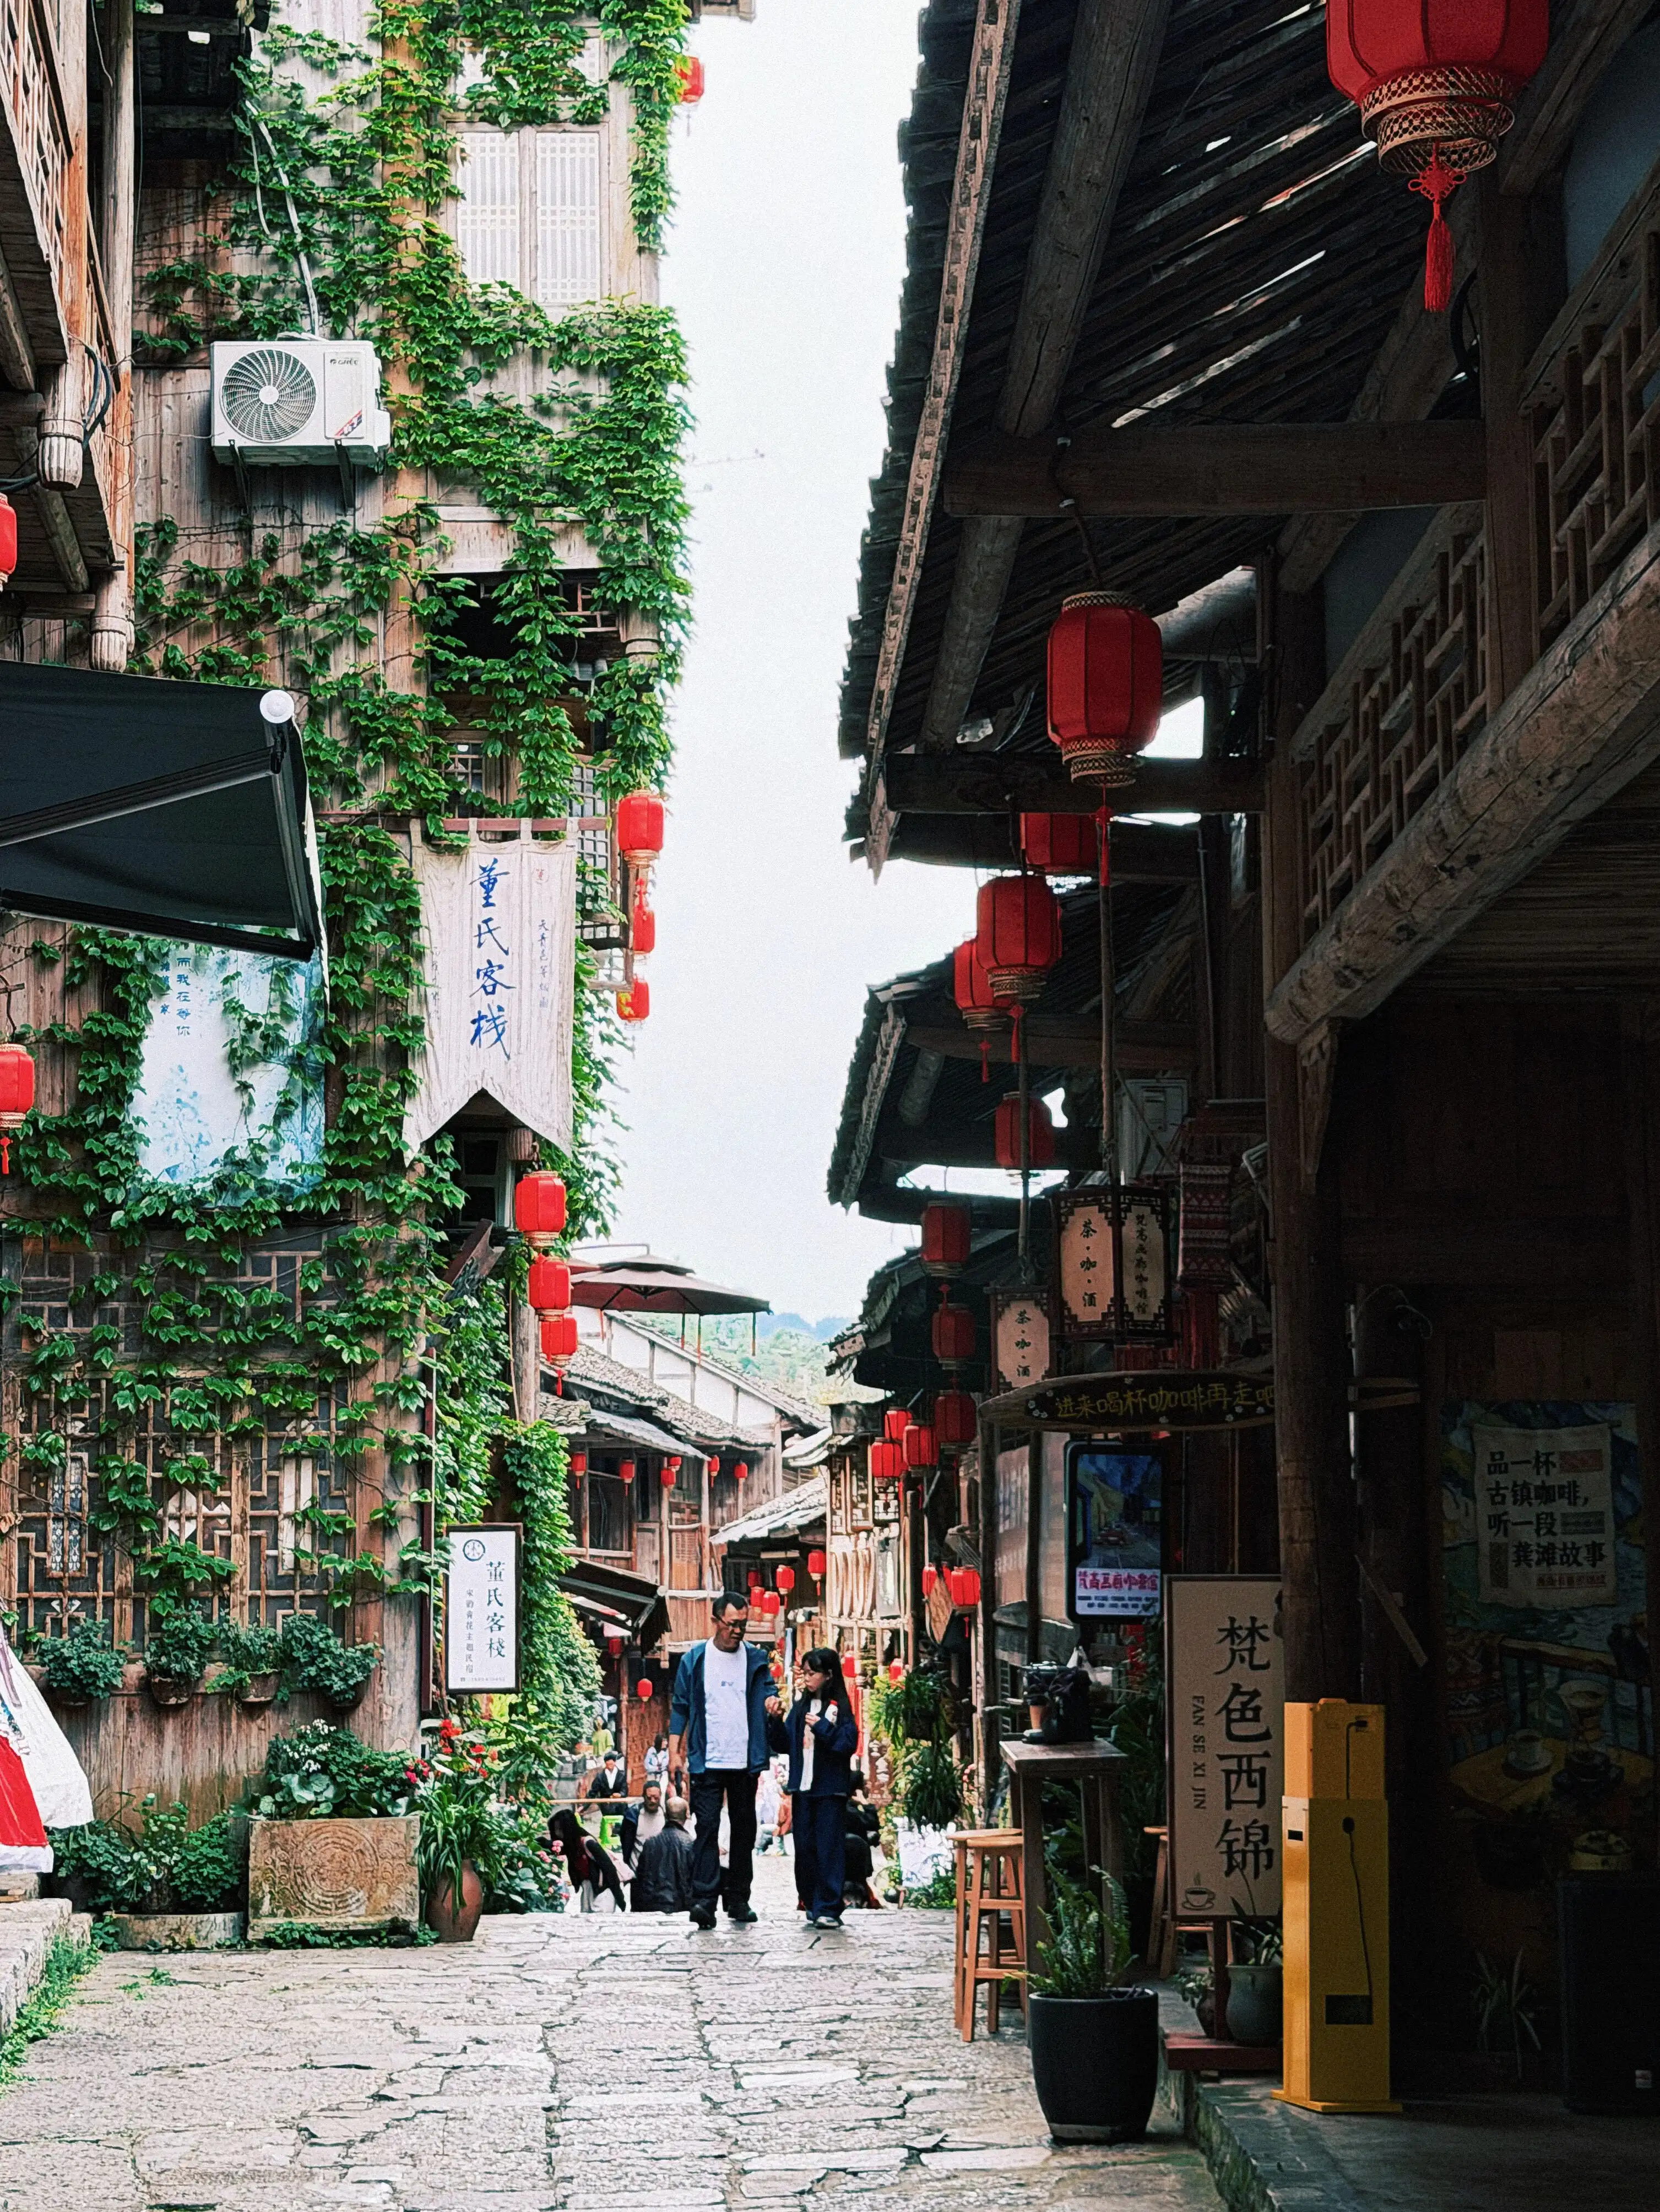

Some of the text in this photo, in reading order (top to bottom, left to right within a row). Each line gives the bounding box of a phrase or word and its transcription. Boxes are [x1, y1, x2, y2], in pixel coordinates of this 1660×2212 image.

[469, 857, 517, 1061] 董氏客栈
[1487, 1450, 1557, 1476] 品一杯
[1488, 1511, 1558, 1538] 听一段
[1192, 1695, 1205, 1810] FAN SE XI JIN
[1213, 1616, 1275, 1880] 梵色西锦
